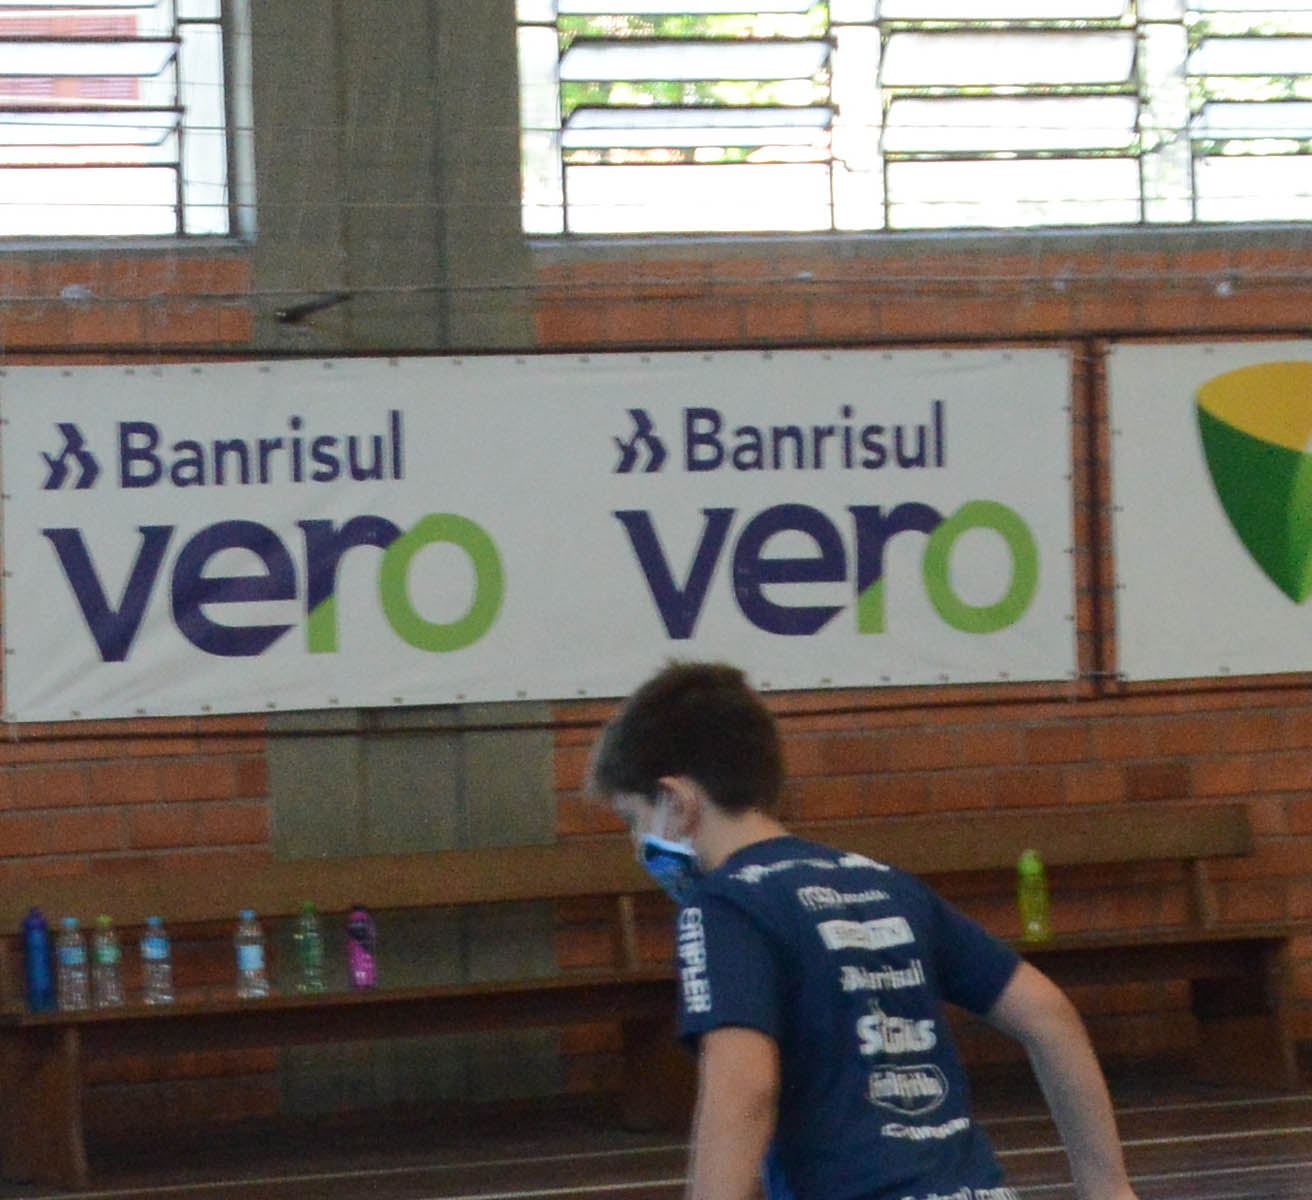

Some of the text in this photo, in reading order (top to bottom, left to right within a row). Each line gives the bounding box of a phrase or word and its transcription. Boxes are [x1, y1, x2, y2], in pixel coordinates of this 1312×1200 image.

[118, 409, 406, 488] Banrisul
[682, 399, 947, 472] Banrisul
[40, 511, 507, 662] vero
[611, 499, 1040, 640] vero
